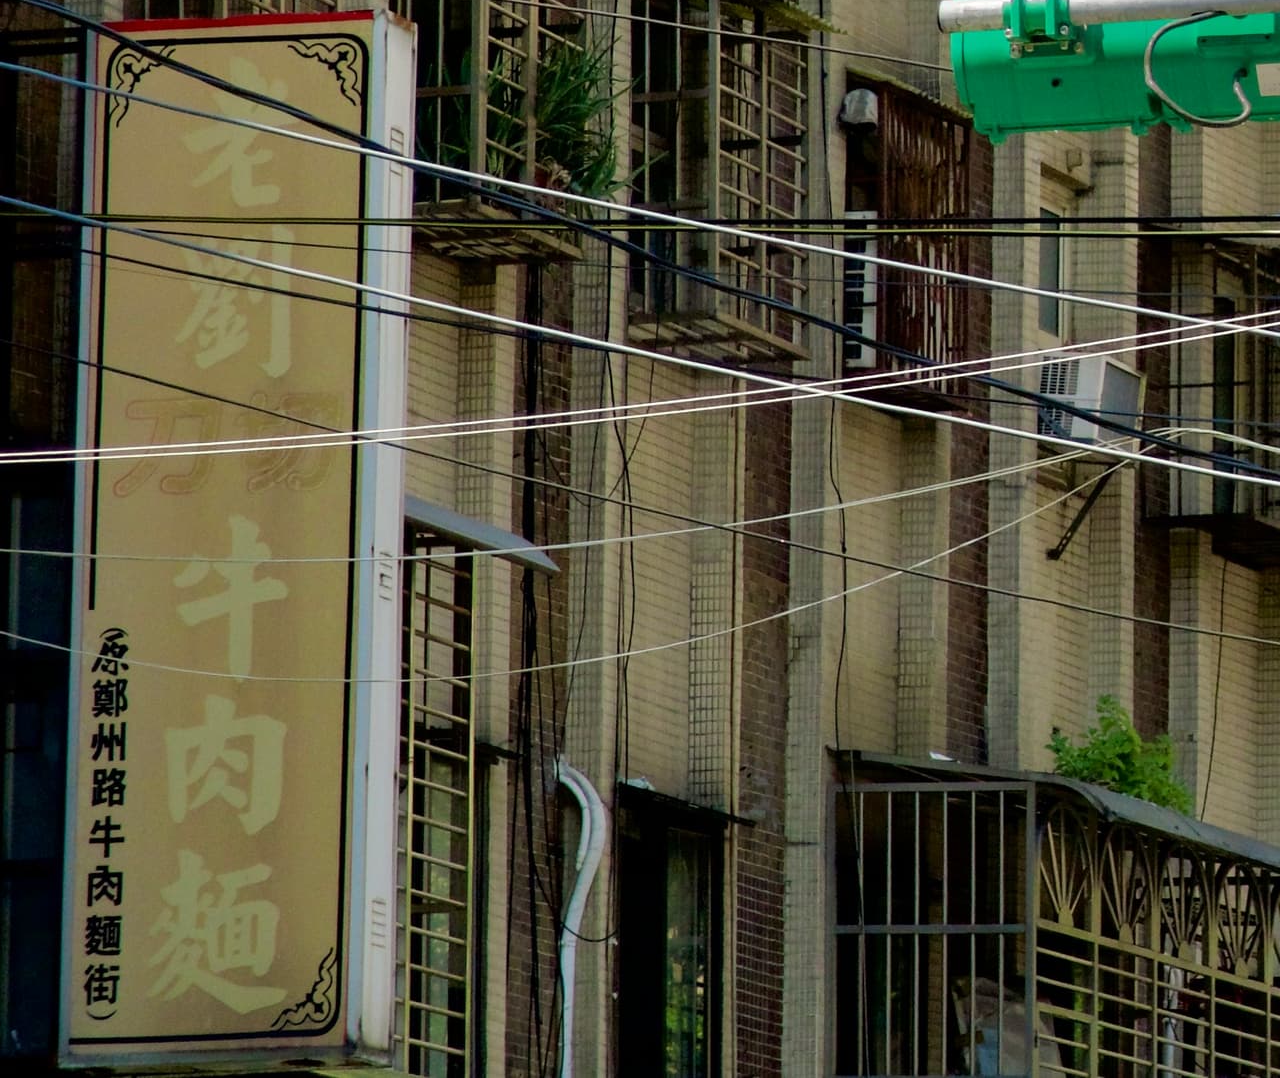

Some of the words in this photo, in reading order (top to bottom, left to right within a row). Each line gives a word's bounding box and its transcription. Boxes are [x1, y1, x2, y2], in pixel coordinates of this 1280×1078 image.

[175, 56, 296, 379] 老劉
[146, 513, 289, 1015] 牛肉麵
